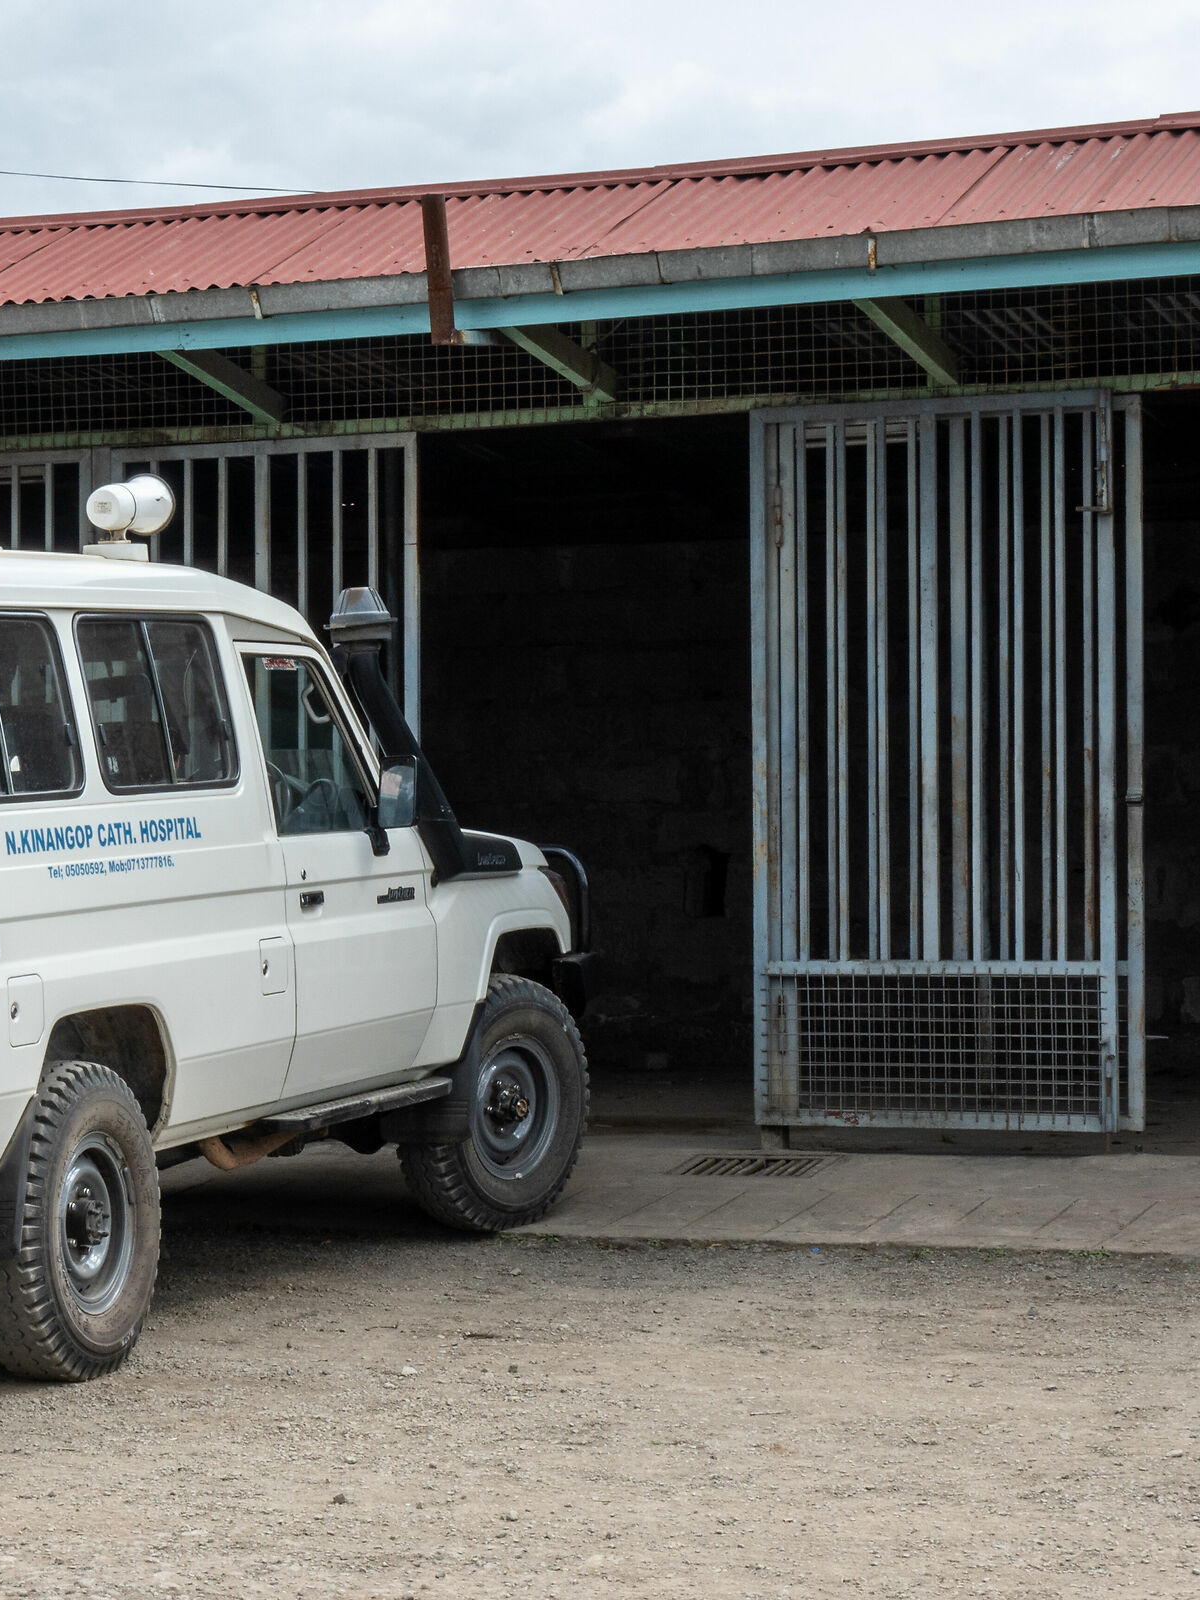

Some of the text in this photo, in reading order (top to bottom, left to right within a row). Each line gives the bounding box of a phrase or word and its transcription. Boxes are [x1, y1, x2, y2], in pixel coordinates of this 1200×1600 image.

[5, 817, 201, 855] N.KINANGOP CATH. HOSPITAL
[48, 866, 64, 880] Tel;
[65, 861, 107, 876] 05050592,
